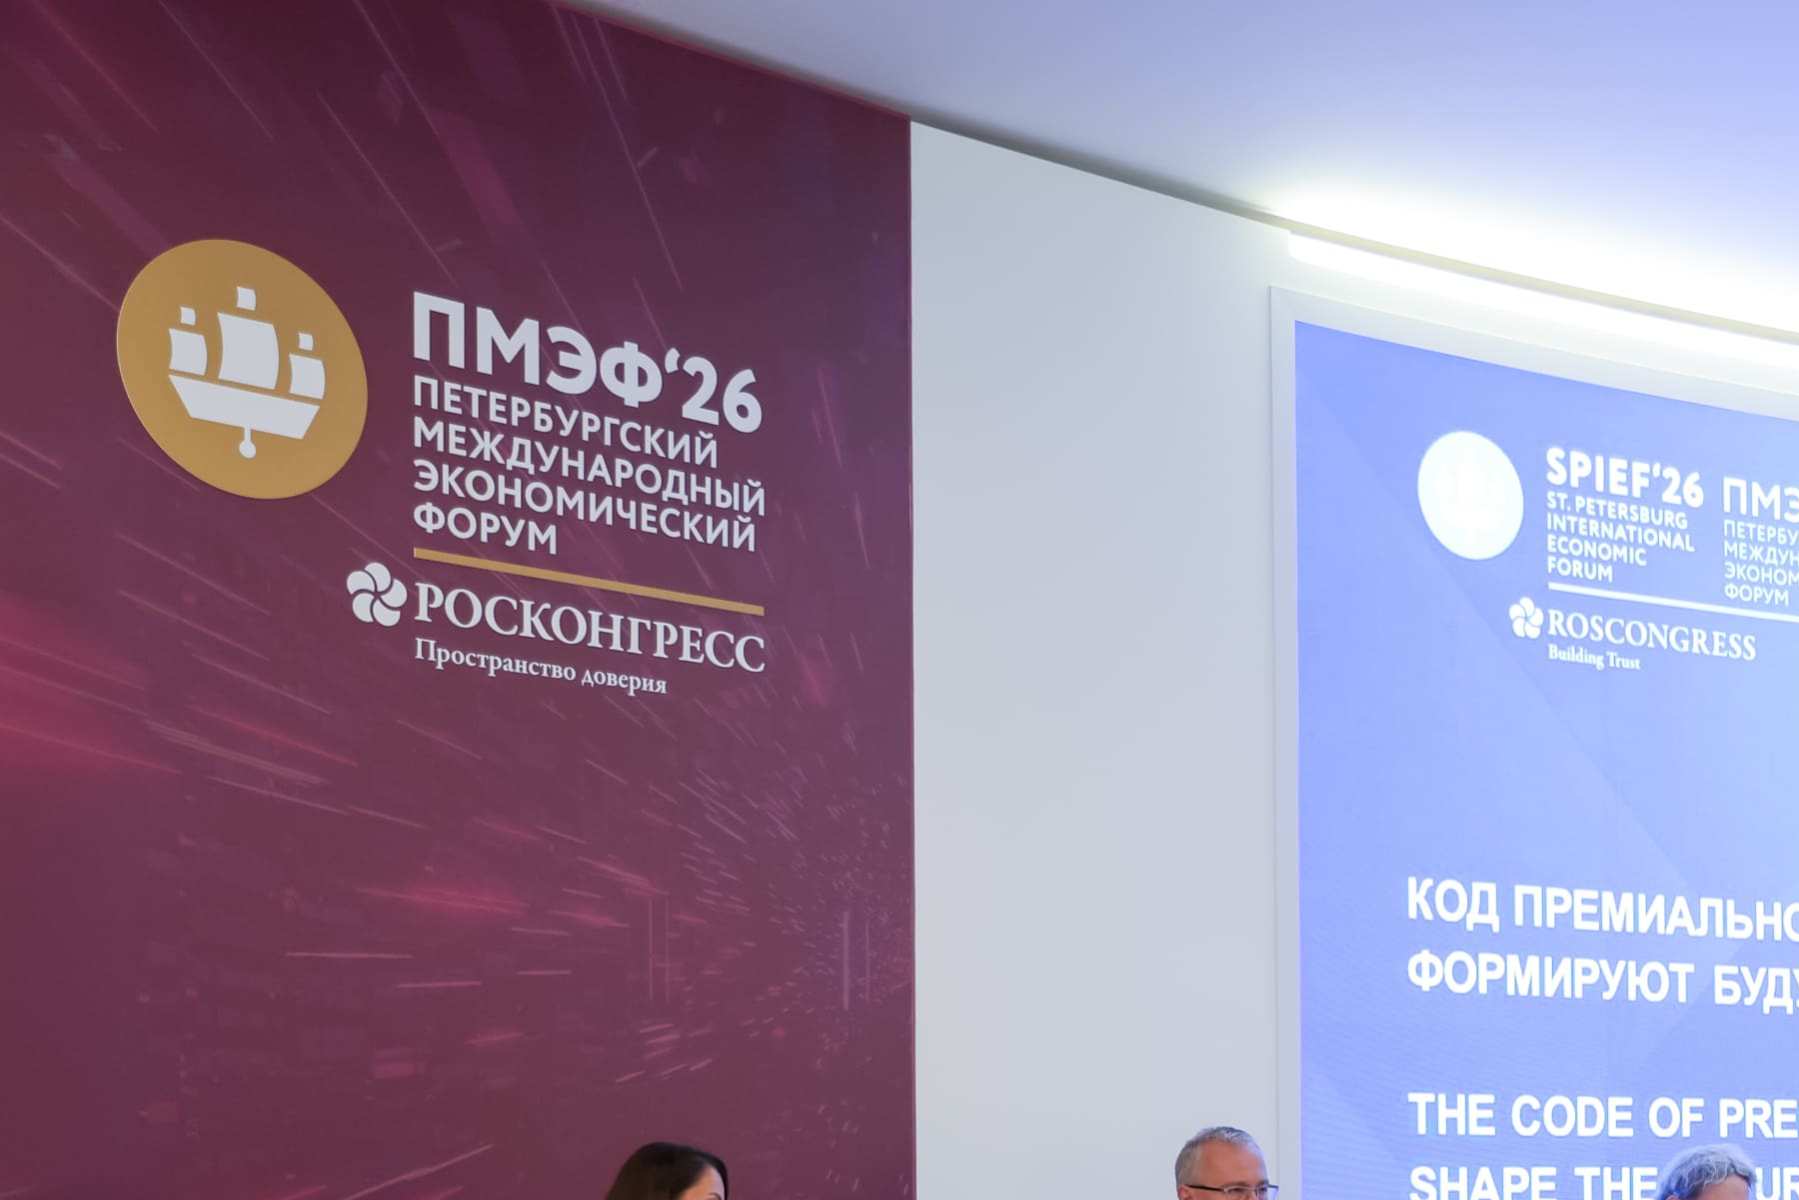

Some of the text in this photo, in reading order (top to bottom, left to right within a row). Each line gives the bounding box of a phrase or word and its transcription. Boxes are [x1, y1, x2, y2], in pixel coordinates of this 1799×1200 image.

[413, 291, 763, 433] ПМЭФ'26
[413, 374, 718, 469] ПЕТЕРБУРГСКИЙ
[413, 416, 766, 517] МЕЖДУНАРОДНЫЙ
[1546, 446, 1704, 508] SPIEF'26
[413, 459, 756, 553] ЭКОНОМИЧЕСКИЙ
[413, 501, 557, 555] ФОРУМ
[1547, 491, 1689, 531] ST. PETERSBURG
[1547, 513, 1696, 553] INTERNATIONAL
[1547, 535, 1648, 567] ECONOMIC
[1547, 556, 1613, 583] FORUM
[1725, 582, 1790, 607] ФОРУМ
[414, 581, 766, 674] РОСКОНГРЕСС
[1548, 609, 1757, 662] ROSCONGRESS
[415, 637, 668, 695] Пространство доверия
[1548, 644, 1641, 671] Building Trust
[1408, 876, 1500, 933] КОД
[1407, 949, 1694, 1003] ФОРМИРУЮТ
[1408, 1092, 1496, 1136] THE
[1511, 1095, 1633, 1138] CODE
[1648, 1097, 1704, 1138] OF
